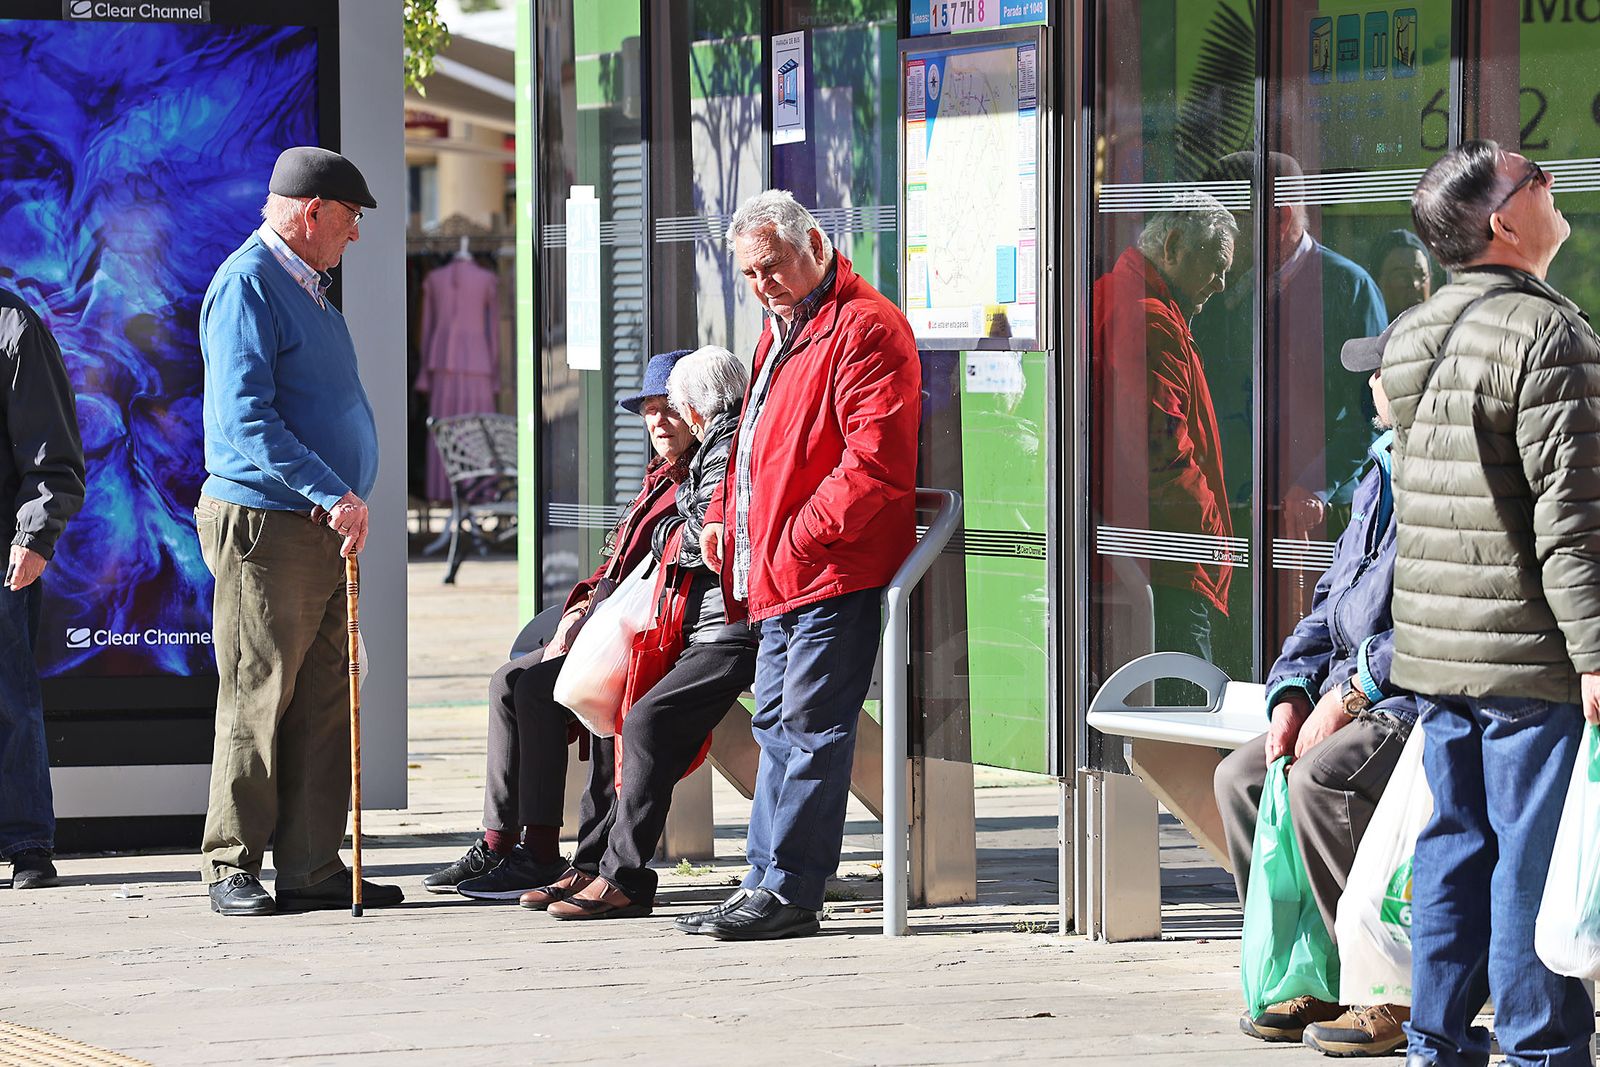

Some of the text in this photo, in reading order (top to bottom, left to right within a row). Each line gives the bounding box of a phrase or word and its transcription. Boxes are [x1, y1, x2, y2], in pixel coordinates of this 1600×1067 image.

[94, 2, 202, 19] Clear Channel
[1003, 5, 1022, 18] Parada
[93, 629, 141, 646] Clear
